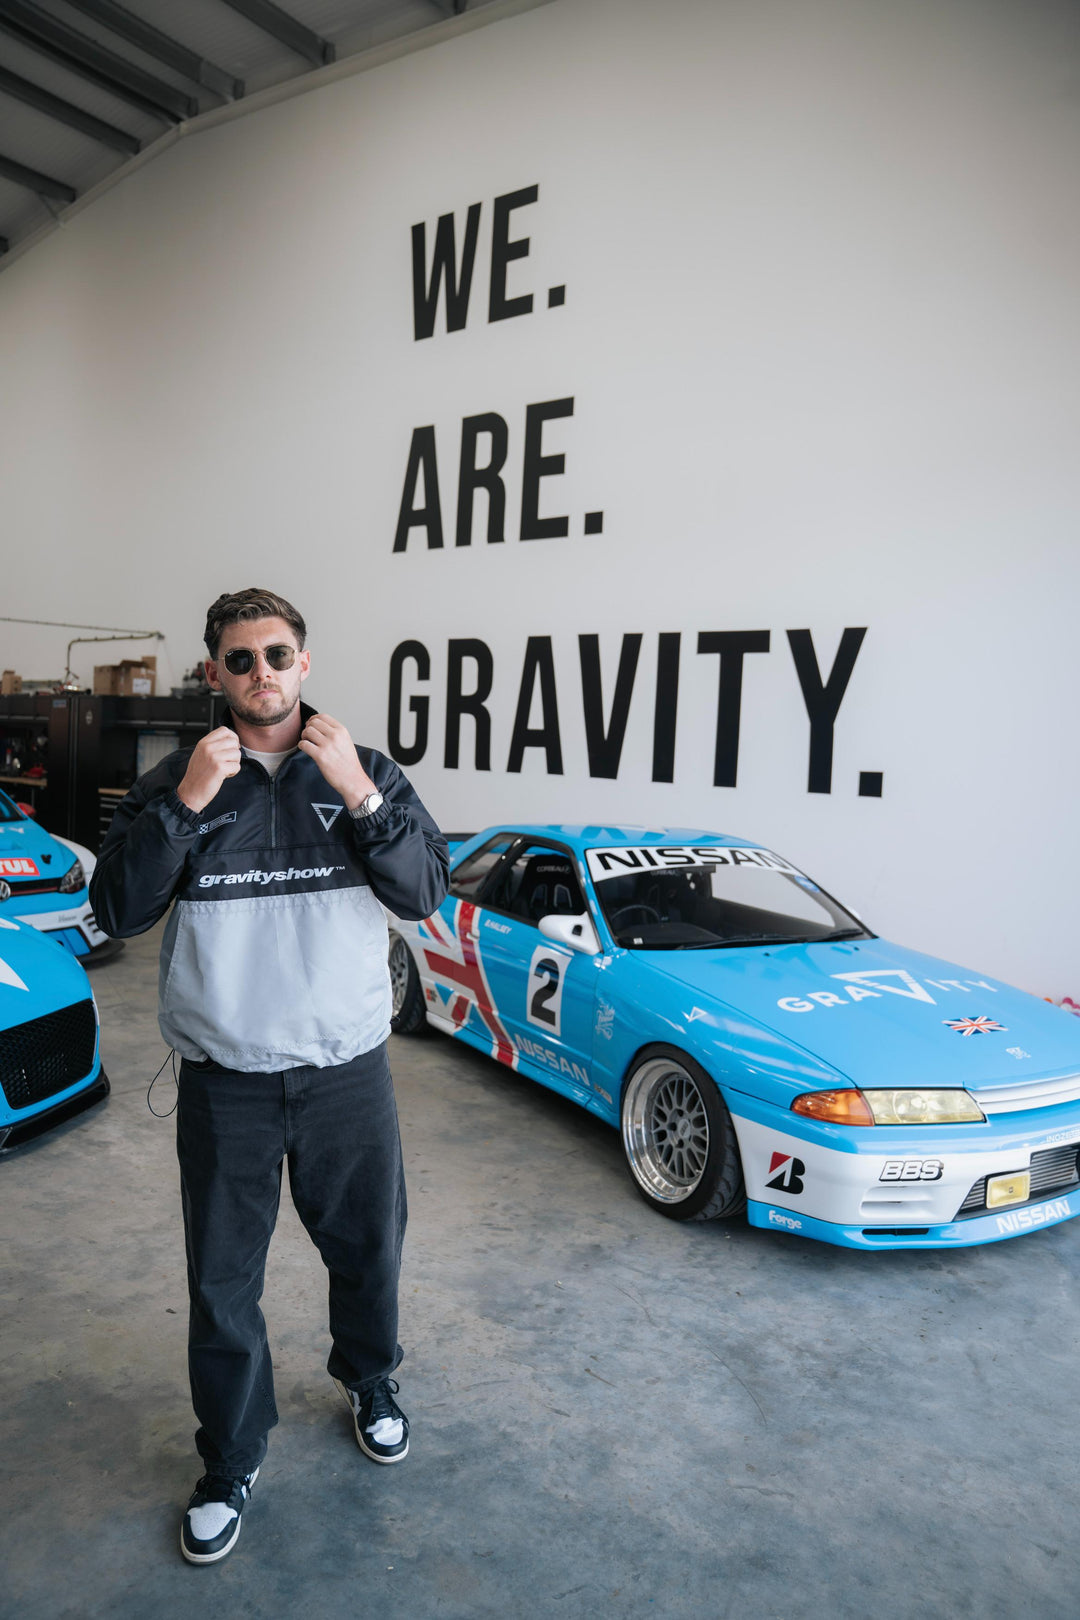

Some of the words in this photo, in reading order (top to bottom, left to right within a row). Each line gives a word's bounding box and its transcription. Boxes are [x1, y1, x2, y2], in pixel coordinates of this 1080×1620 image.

[411, 183, 566, 342] WE.
[392, 396, 603, 553] ARE.
[387, 626, 884, 798] GRAVITY.
[595, 848, 790, 872] NISSAN
[531, 958, 560, 1027] 2
[514, 1033, 591, 1086] NISSAN
[879, 1159, 945, 1182] BBS
[996, 1199, 1072, 1234] NISSAN
